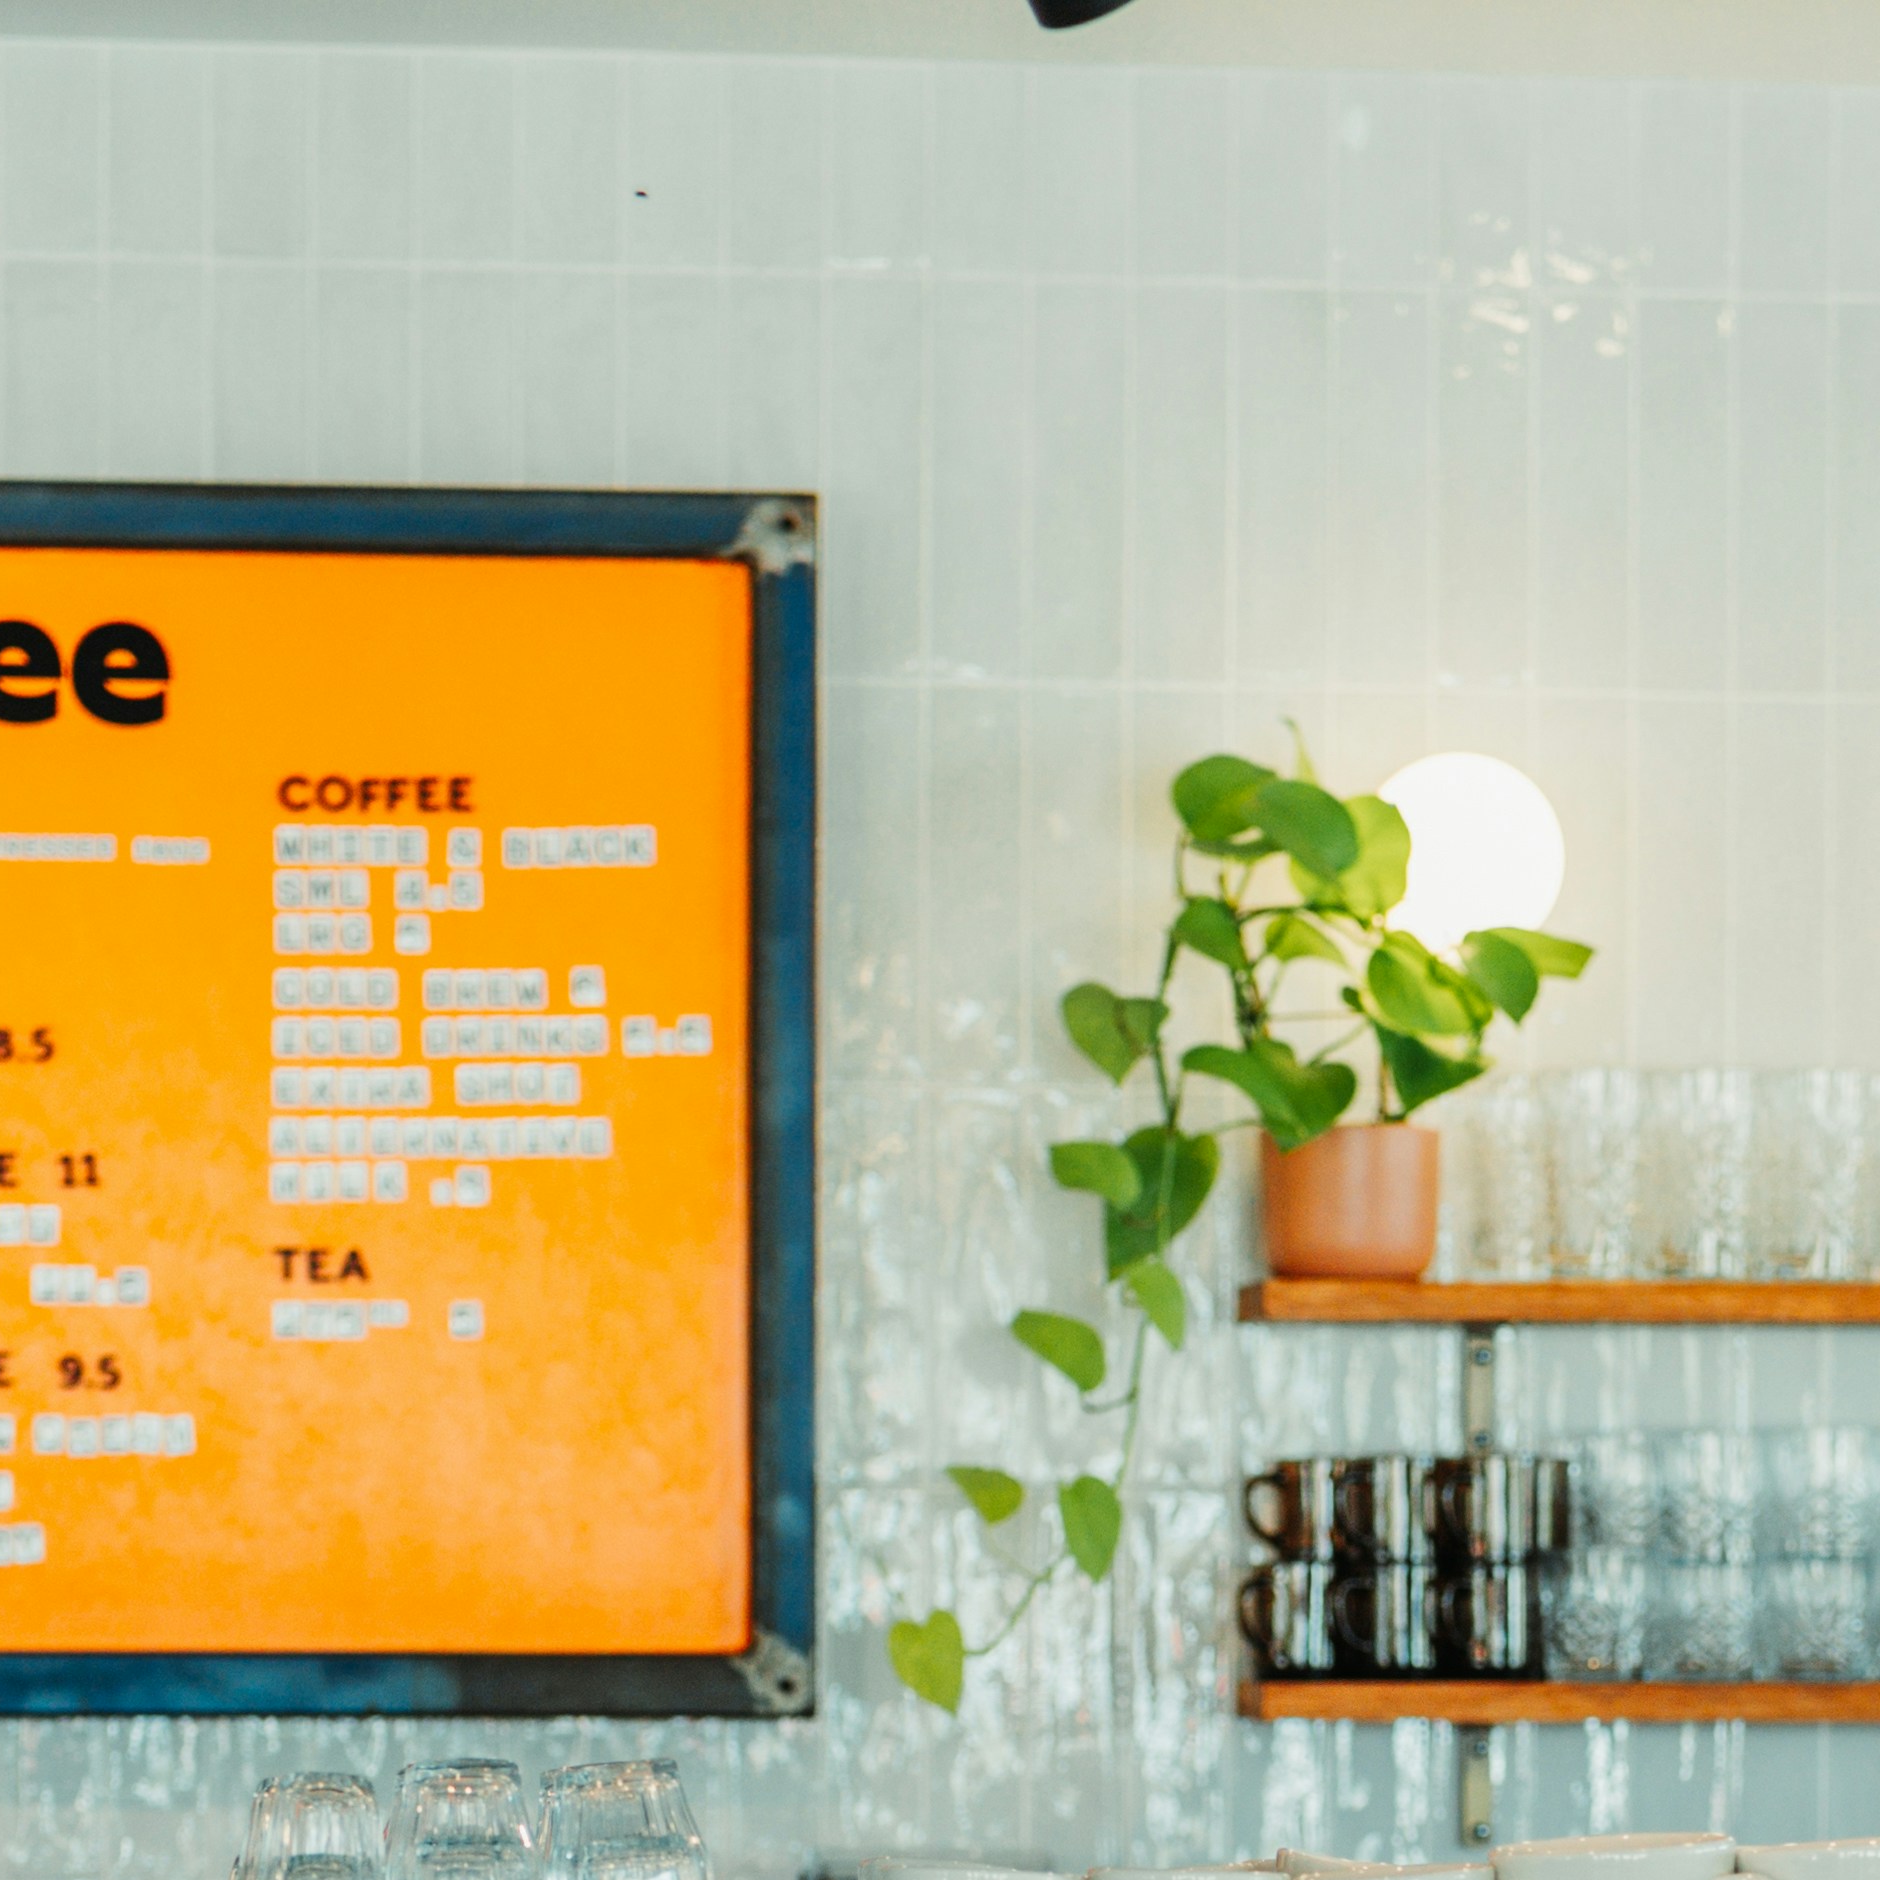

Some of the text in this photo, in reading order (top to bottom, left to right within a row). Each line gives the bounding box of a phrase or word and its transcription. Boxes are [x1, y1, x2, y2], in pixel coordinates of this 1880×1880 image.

[278, 775, 471, 813] COFFEE
[507, 829, 652, 864] BLACK
[59, 1153, 99, 1187] 11
[275, 1247, 368, 1283] TEA
